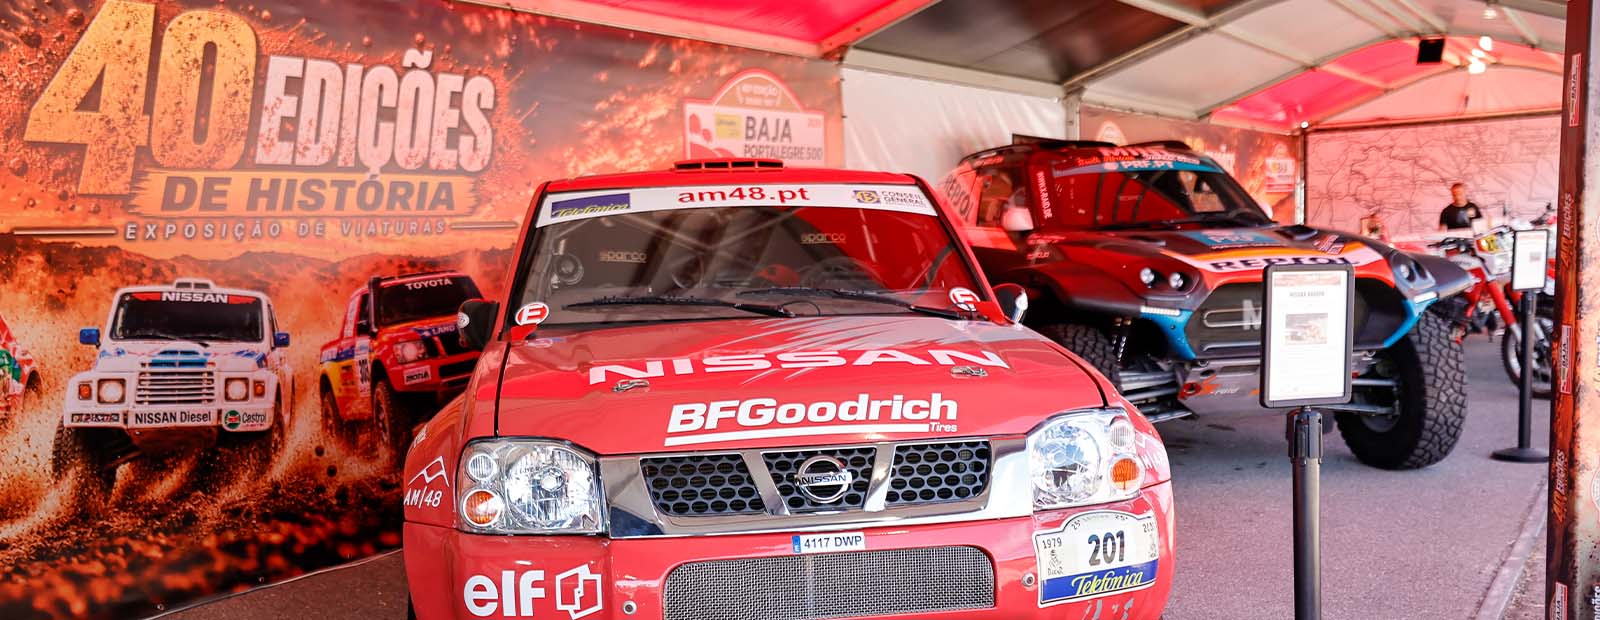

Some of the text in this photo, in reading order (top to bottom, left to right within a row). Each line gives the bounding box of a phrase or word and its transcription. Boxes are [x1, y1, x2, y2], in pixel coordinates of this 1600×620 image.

[24, 0, 257, 196] 40
[255, 48, 496, 178] EDIÇÕES
[745, 116, 792, 142] BAJA
[744, 144, 822, 161] PORTALEGRE 500
[160, 172, 455, 212] DE HISTÓRIA
[678, 186, 810, 205] am48.pt
[124, 219, 446, 240] EXPOSIÇÃO DE VIATURAS
[801, 233, 846, 242] sparco
[405, 278, 453, 291] TOYOTA
[161, 291, 229, 304] NISSAN
[431, 325, 455, 336] LAND
[589, 350, 1010, 385] NISSAN
[135, 411, 177, 424] NISSAN
[180, 410, 211, 423] Diesel
[242, 411, 266, 423] Castrol
[666, 393, 958, 433] BFGoodrich
[929, 422, 958, 433] Tires
[801, 474, 846, 484] NISSAN
[804, 537, 830, 549] 4117
[834, 535, 862, 547] DWP
[1042, 537, 1062, 549] 1979
[1088, 530, 1125, 566] 201
[464, 570, 546, 618] elf
